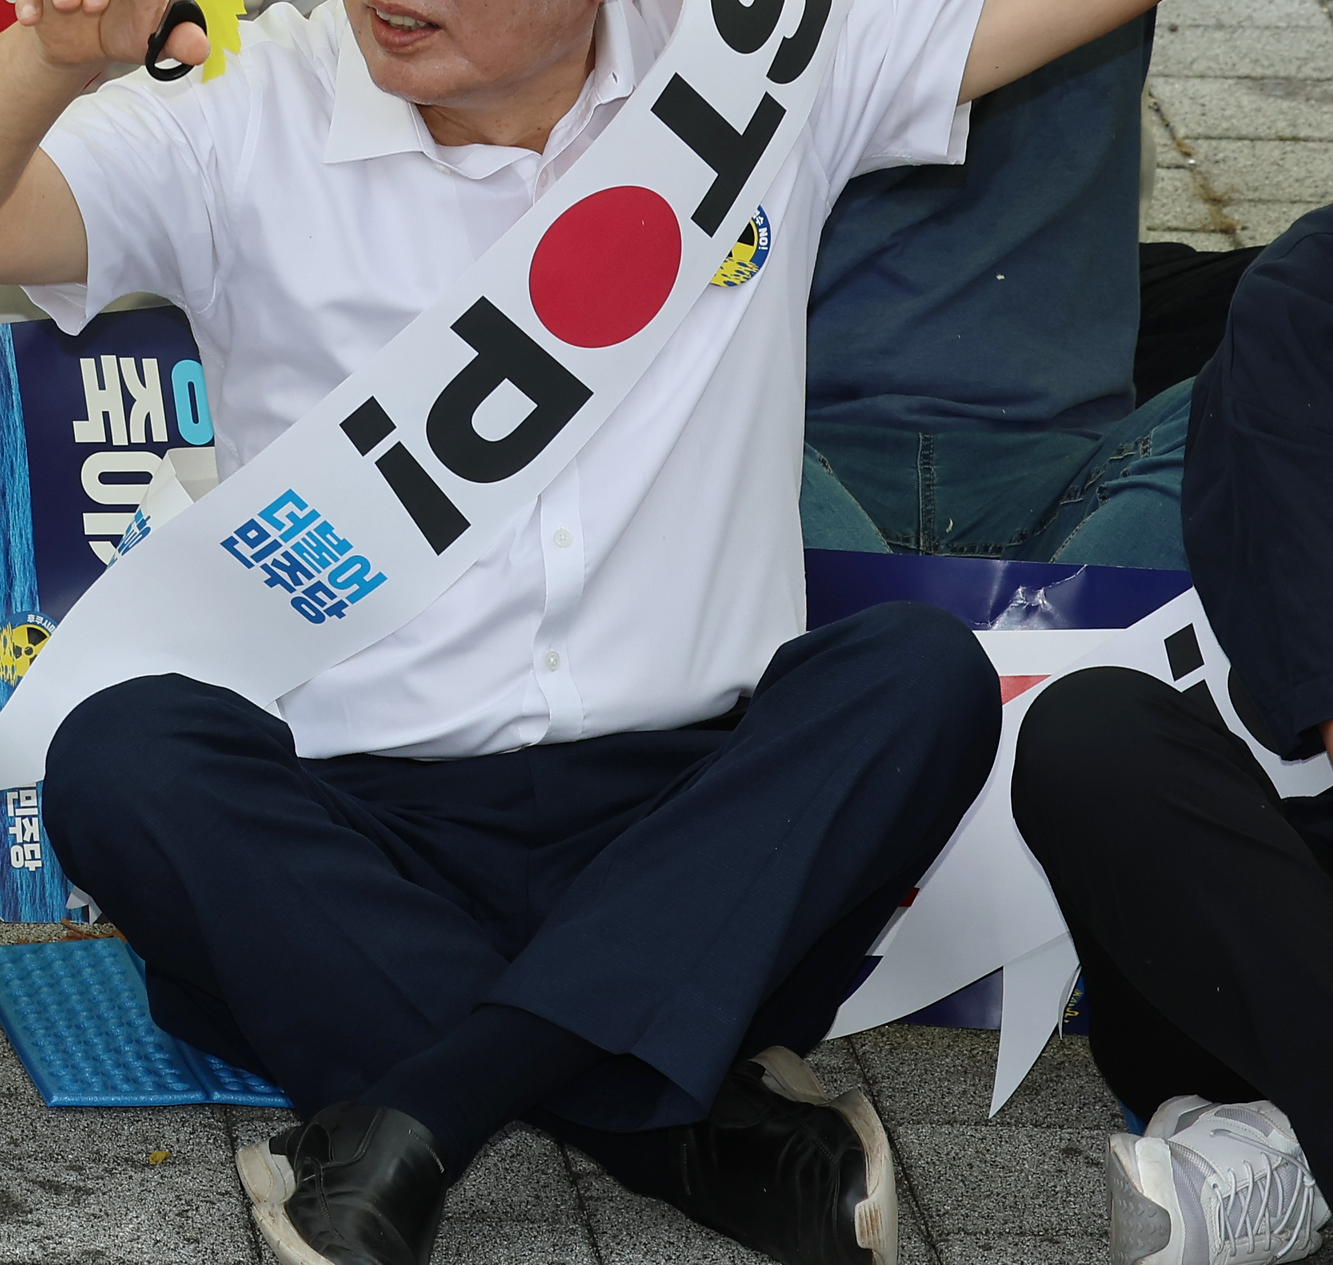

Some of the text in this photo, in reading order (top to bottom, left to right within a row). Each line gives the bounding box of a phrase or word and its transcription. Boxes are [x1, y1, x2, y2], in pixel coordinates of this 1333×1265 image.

[758, 227, 769, 250] NO!
[220, 518, 351, 626] 민주당
[258, 486, 388, 602] 더불어
[7, 784, 43, 872] 민주당
